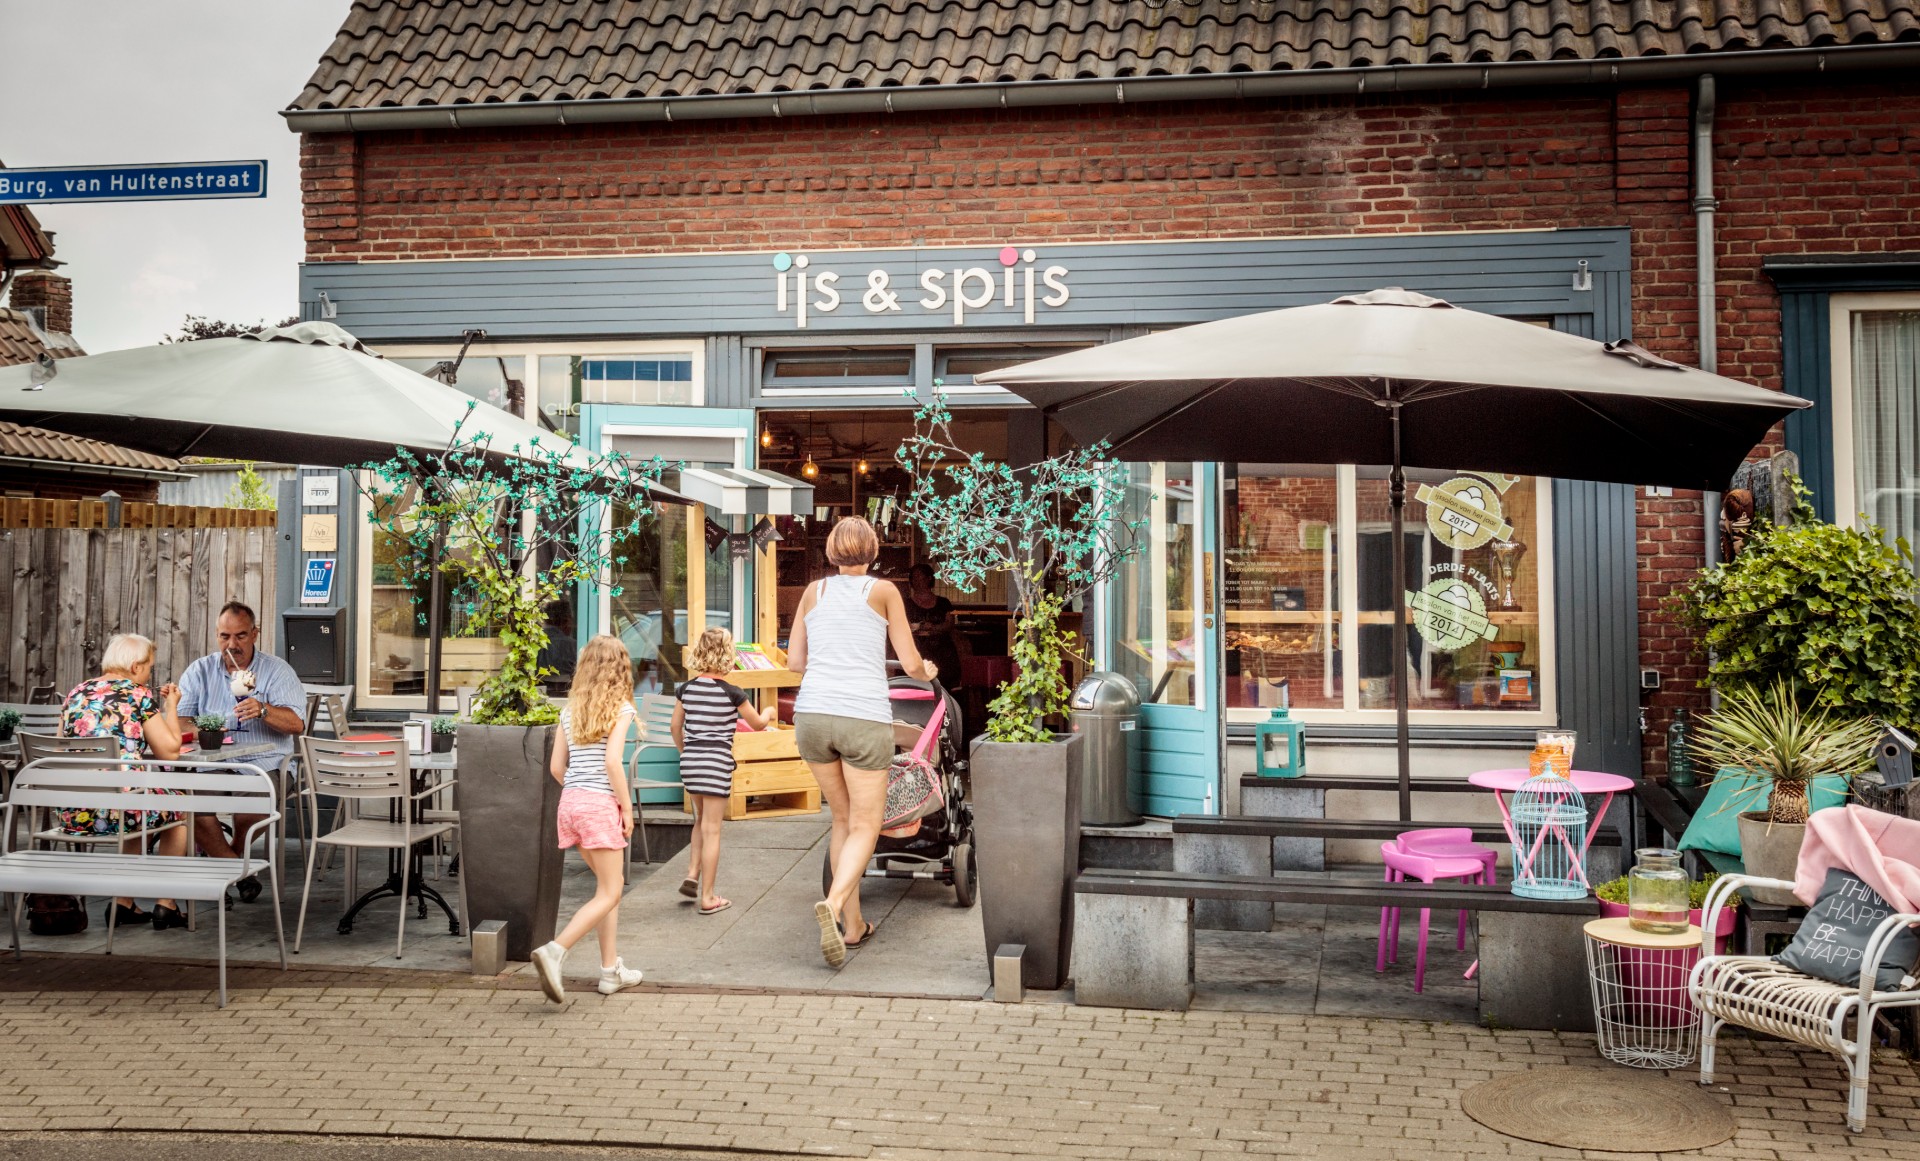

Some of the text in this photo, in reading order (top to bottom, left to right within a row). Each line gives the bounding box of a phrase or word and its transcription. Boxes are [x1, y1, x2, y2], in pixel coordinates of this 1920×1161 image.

[0, 170, 250, 198] Burg. van Hultenstraat
[773, 246, 1070, 328] ijs & spijs
[1434, 492, 1497, 526] ijssalon van het jaar
[1448, 514, 1471, 529] 2017
[1428, 562, 1500, 601] DERDE PLAATS
[302, 590, 328, 598] Horeca
[1444, 608, 1457, 617] van
[320, 625, 330, 634] 1a
[1430, 615, 1460, 635] 2014
[1812, 922, 1847, 943] BE
[1801, 940, 1865, 967] HAPP
